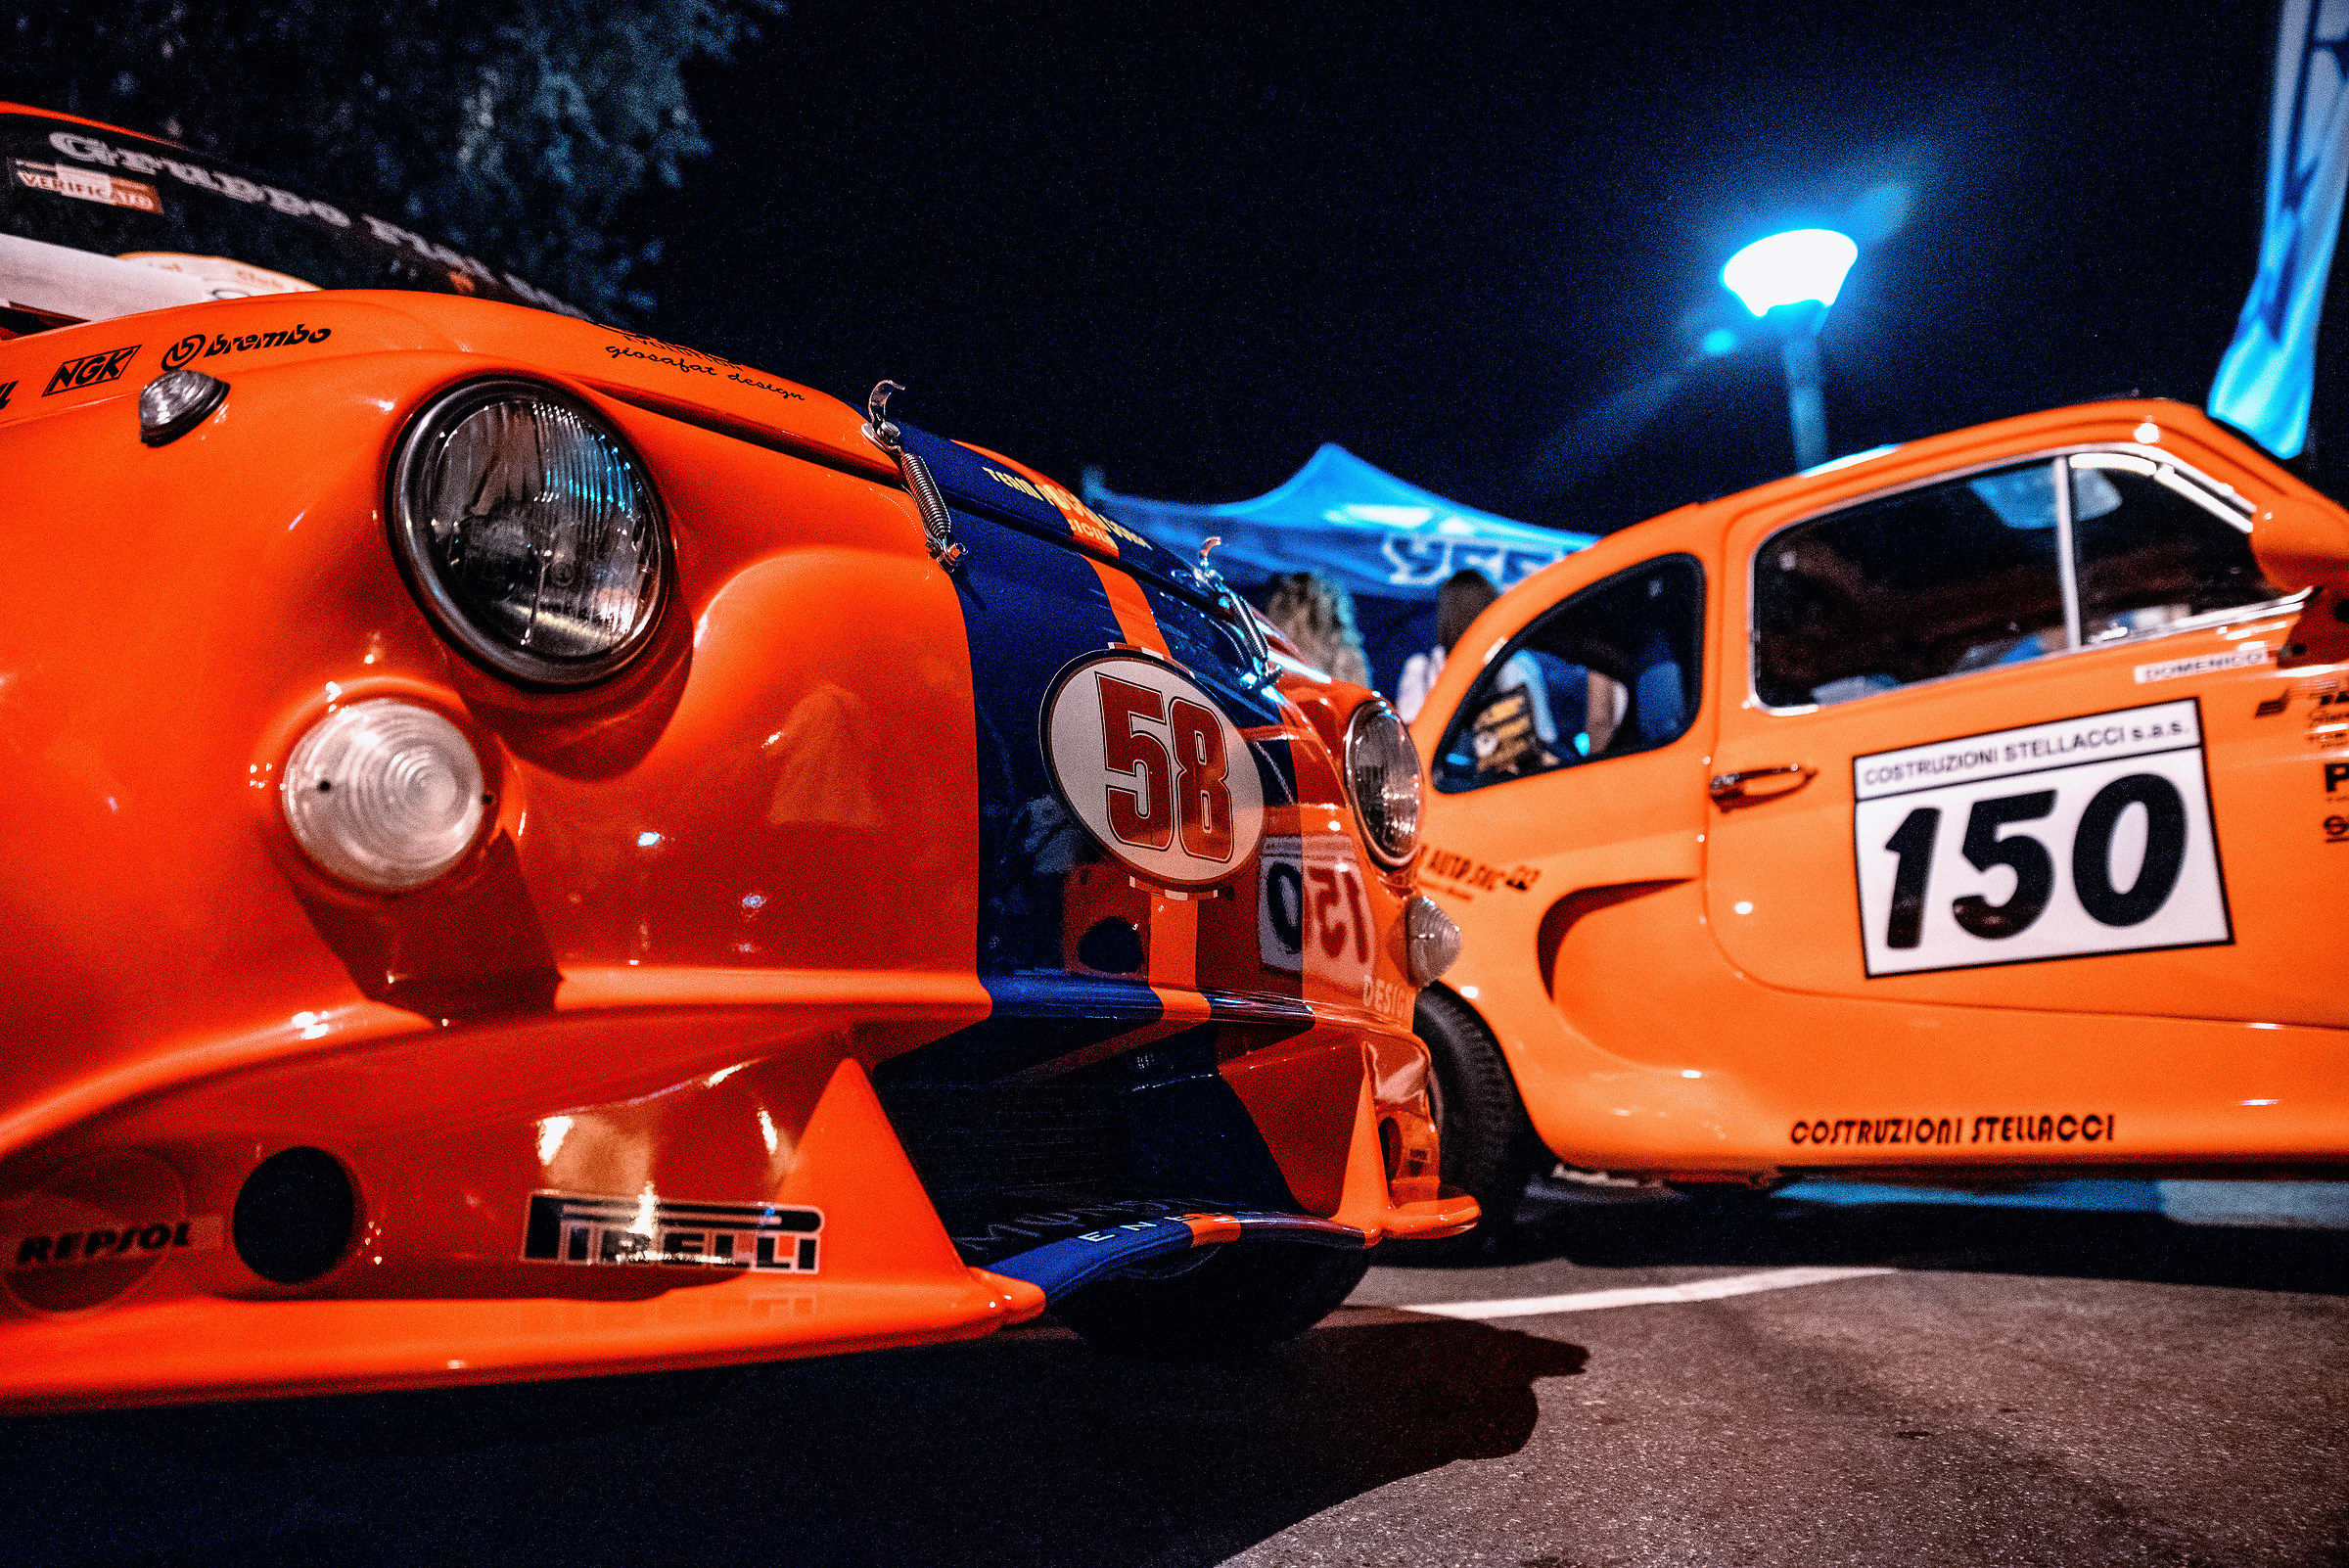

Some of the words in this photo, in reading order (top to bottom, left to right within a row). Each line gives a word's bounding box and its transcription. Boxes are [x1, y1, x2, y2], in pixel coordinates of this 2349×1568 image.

[18, 170, 155, 210] VERIFICATO
[49, 131, 349, 227] Gruppo
[204, 324, 332, 358] brembo
[48, 346, 135, 392] NGK
[605, 345, 717, 376] giosafat
[727, 372, 806, 400] design
[1094, 670, 1234, 865] 58
[1864, 749, 1998, 785] COSTRUZIONI
[2004, 726, 2125, 761] STELLACCI
[2132, 720, 2189, 741] s.a.s.
[1884, 771, 2189, 949] 150
[1791, 1118, 1962, 1145] COSTRUZIONI
[1971, 1114, 2115, 1143] STELLACCI
[17, 1222, 190, 1264] REPSOL
[522, 1190, 825, 1274] PIRELLI
